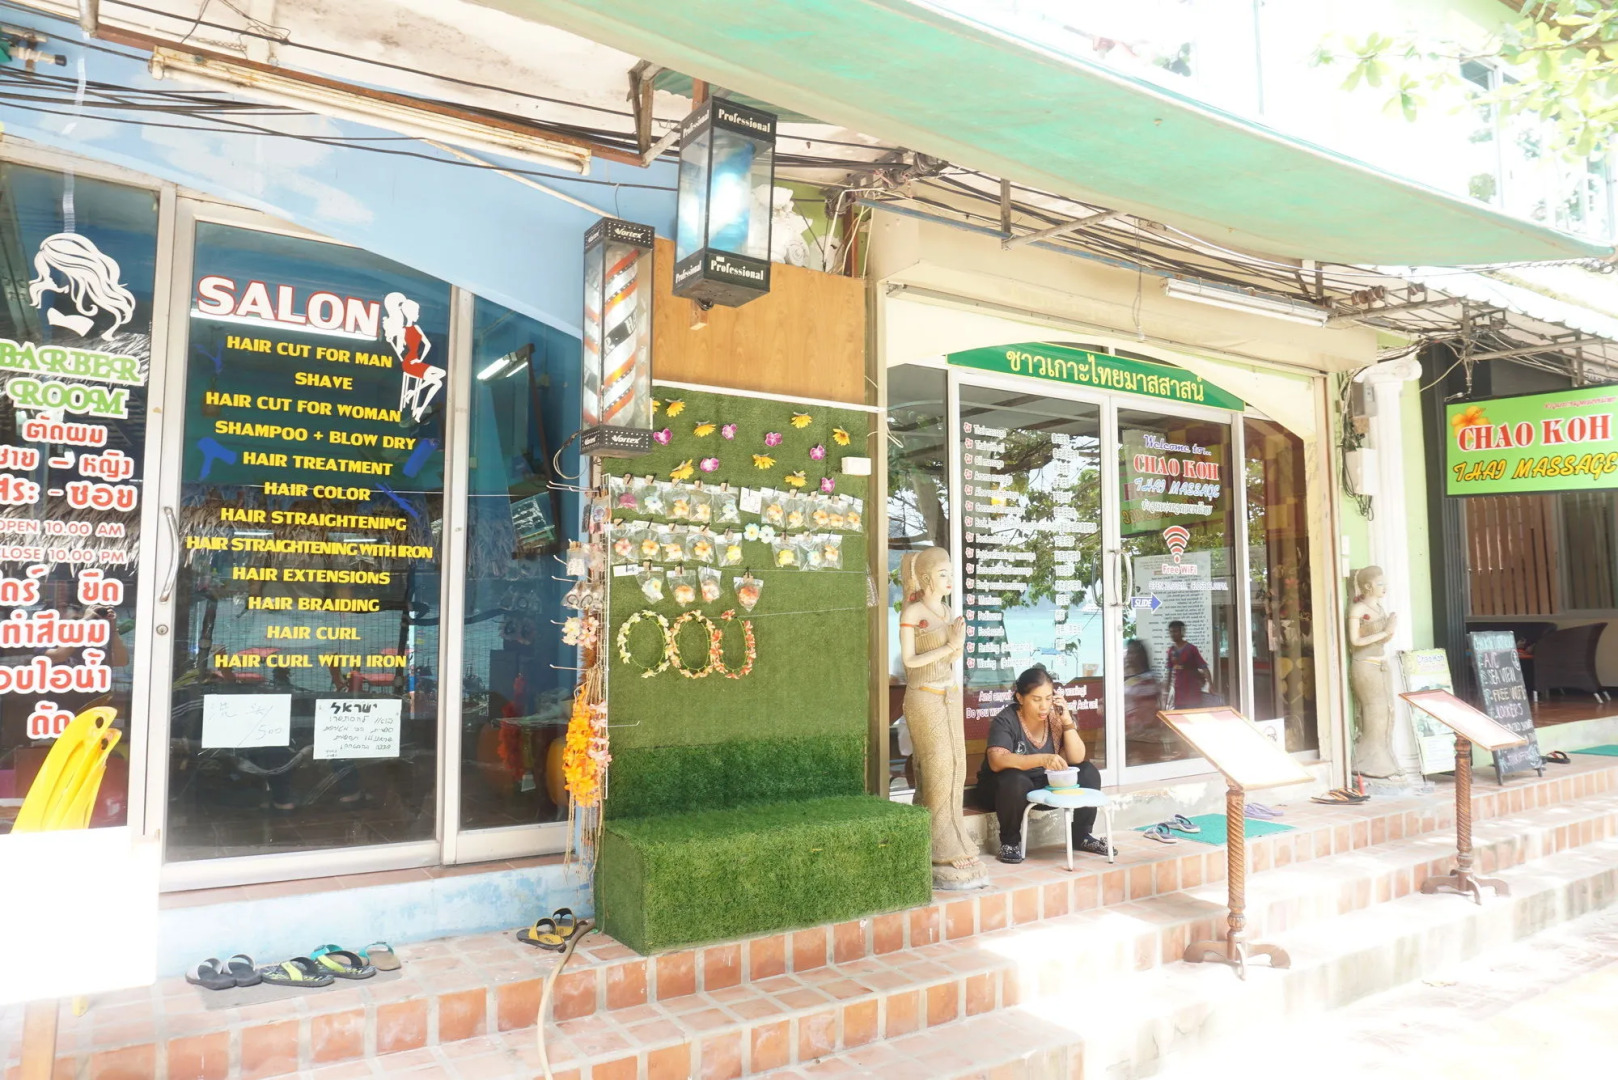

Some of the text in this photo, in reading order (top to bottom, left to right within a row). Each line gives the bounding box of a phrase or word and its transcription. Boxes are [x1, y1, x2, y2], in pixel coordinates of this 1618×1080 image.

[718, 108, 771, 133] Professional
[614, 227, 645, 239] Vortex
[710, 259, 764, 281] Professional
[196, 275, 380, 338] SALON
[0, 341, 141, 382] BARBER
[226, 335, 392, 368] HAIR CUT FOR MAN
[294, 372, 353, 390] SHAVE
[9, 380, 126, 415] ROOM
[205, 391, 401, 422] HAIR CUT FOR WOMAN
[26, 415, 104, 444] ตัดผม
[214, 420, 308, 441] SHAMPOO
[328, 430, 378, 448] BLOW
[382, 435, 416, 450] DRY
[611, 434, 642, 444] Vortex
[1458, 414, 1612, 452] CHAO KOH
[1144, 434, 1191, 453] Welcome
[243, 452, 393, 476] HAIR TREATMENT
[1134, 454, 1220, 480] CHAO KOH
[1453, 451, 1618, 482] THAI MASSAGE
[263, 481, 371, 501] HAIR COLOR
[97, 524, 122, 536] AM
[220, 507, 407, 531] HAIR STRAIGHTENING
[0, 547, 41, 560] LOSE
[101, 551, 125, 563] PM
[186, 535, 433, 559] HAIR STRAIGHTENING WITH IRON
[232, 566, 391, 585] HAIR EXTENSIONS
[1162, 564, 1197, 574] Free WiFi
[248, 597, 380, 612] HAIR BRAIDING
[1134, 599, 1152, 608] SLIDE
[3, 612, 105, 644] ทำสีผม
[267, 626, 361, 641] HAIR CURL
[214, 655, 407, 668] HAIR CURL WITH IRON
[330, 702, 377, 715] ישראל
